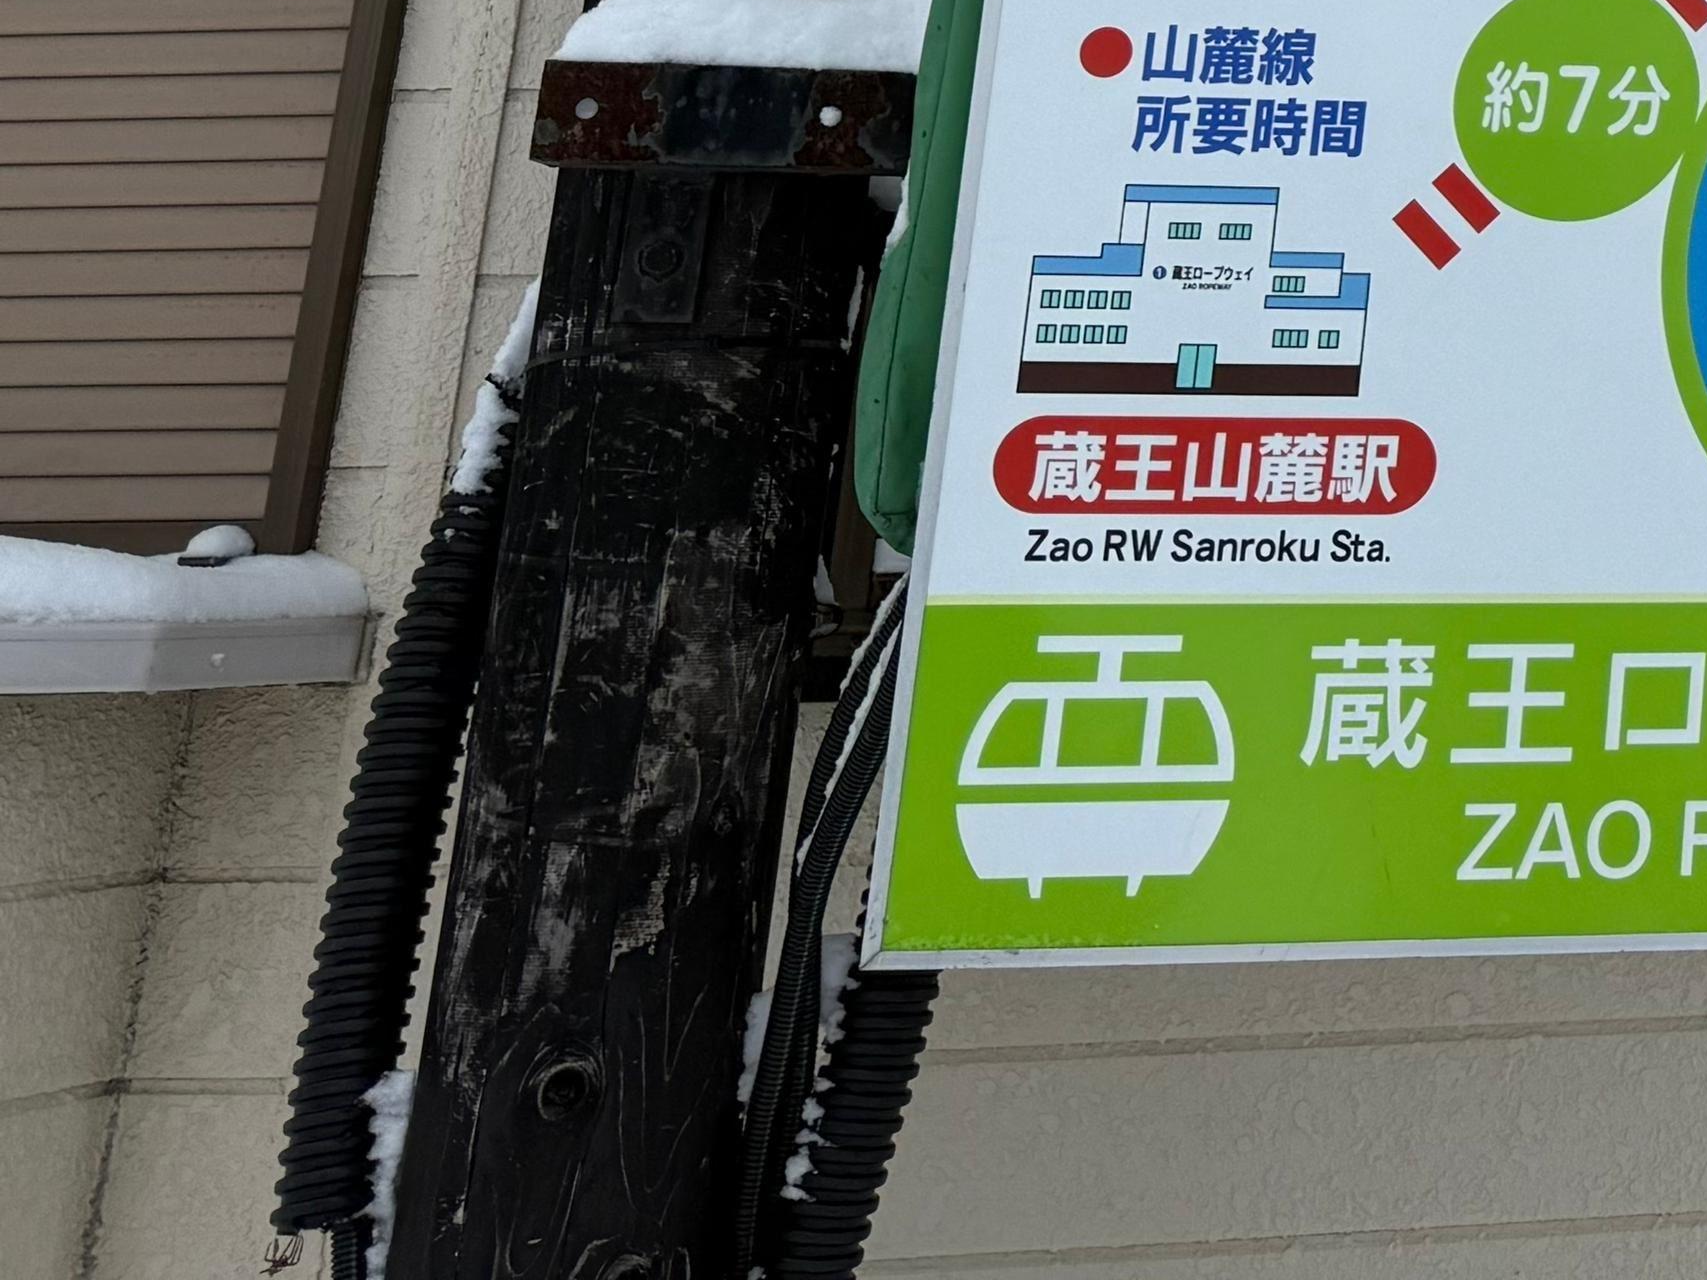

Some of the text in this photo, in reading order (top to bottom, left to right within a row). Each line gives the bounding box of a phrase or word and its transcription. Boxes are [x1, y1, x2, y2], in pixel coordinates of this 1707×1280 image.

[1140, 24, 1317, 87] 山麓線
[1131, 95, 1368, 159] 所要時間
[1481, 60, 1671, 136] 約7分
[1182, 282, 1197, 290] ZAO
[1027, 431, 1400, 505] 蔵王山麓駅
[1024, 528, 1391, 564] Zao RW Sanroku Sta.
[1455, 794, 1649, 882] ZAO
